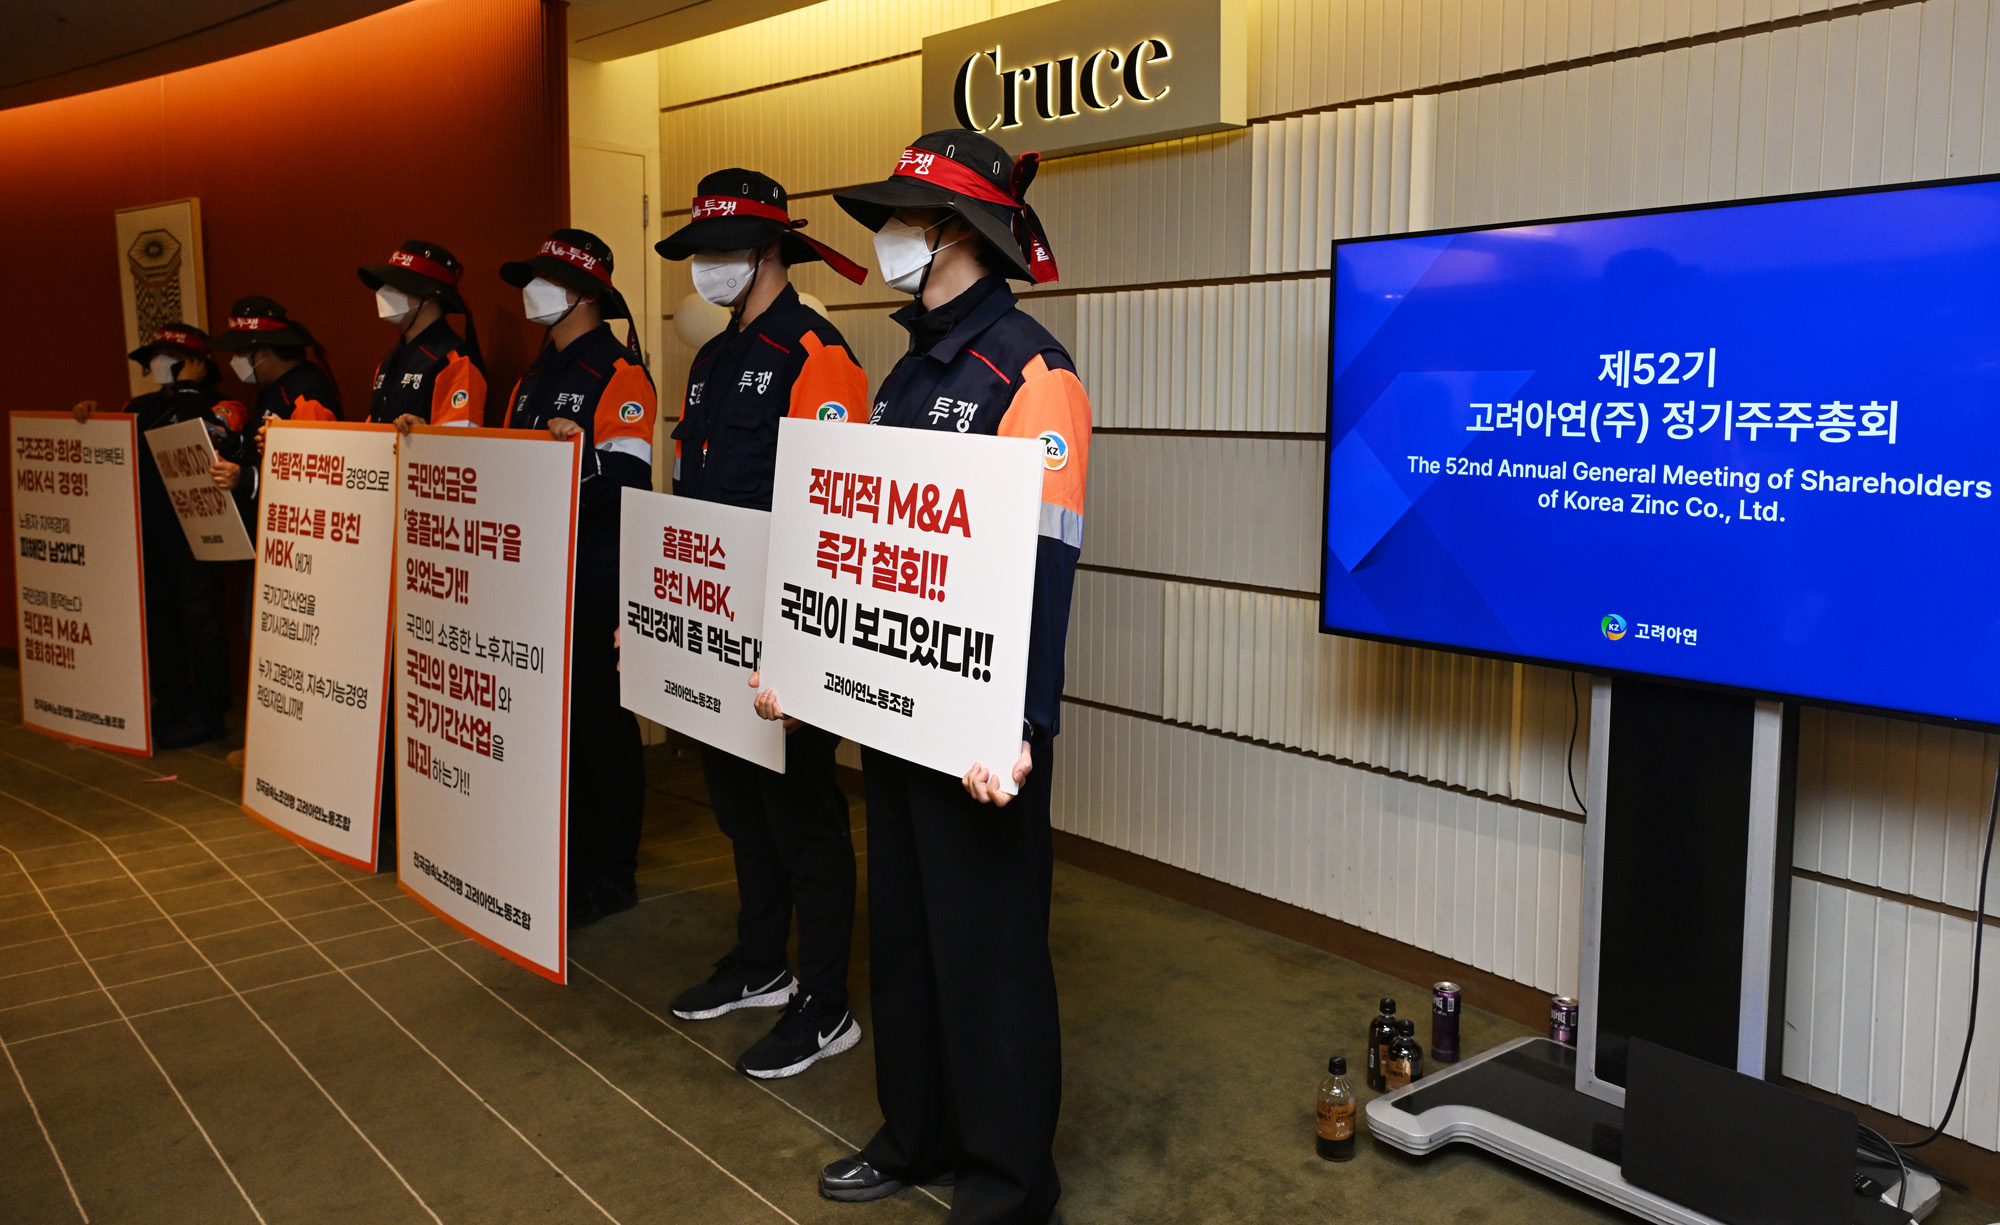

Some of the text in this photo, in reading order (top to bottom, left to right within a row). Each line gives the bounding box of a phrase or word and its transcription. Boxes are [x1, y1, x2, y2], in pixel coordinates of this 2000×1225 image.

[953, 38, 1172, 134] Cruce
[899, 150, 936, 175] 투쟁
[566, 246, 597, 270] 투쟁
[401, 373, 423, 390] 투쟁
[738, 370, 773, 395] 투쟁
[1597, 347, 1717, 388] 제52기
[554, 393, 585, 413] 투쟁
[827, 412, 838, 420] KZ
[928, 396, 979, 433] 투쟁
[1465, 399, 1899, 445] 고려아연(주) 정기주주총회
[271, 451, 390, 492] 약탈적·무책임 경영으로
[1046, 446, 1059, 456] KZ
[17, 468, 89, 497] MBK식 경영!
[407, 462, 478, 505] 국민연금은
[1407, 455, 1993, 500] The 52nd Annual General Meeting of Shareholders
[266, 502, 326, 540] 홈플러스를
[330, 511, 361, 545] 망친
[808, 467, 972, 539] 적대적 M&A
[1538, 489, 1786, 523] of Korea Zinc Co., Ltd.
[662, 525, 726, 571] 홈플러스
[816, 530, 949, 603] 즉각 철회!!
[263, 584, 316, 616] 국가기간산업을
[406, 557, 469, 605] 잊었는가!!
[653, 566, 735, 622] 망친 MBK,
[23, 611, 93, 646] 적대적 M&A
[261, 612, 320, 646] 맡기시겠습니까?
[406, 613, 544, 674] 국민의 소중한 노후자금이
[627, 600, 684, 649] 국민경제
[687, 619, 703, 655] 좀
[781, 581, 994, 683] 국민이 보고있다!!
[1608, 623, 1619, 631] KZ
[1634, 623, 1697, 646] 고려아연
[25, 637, 75, 670] 철회하라!!
[406, 648, 445, 695] 국민의
[258, 657, 272, 681] 누가
[306, 674, 368, 710] 지속가능경영
[664, 679, 721, 714] 고려아연노동조합
[823, 671, 915, 718] 고려아연노동조합
[406, 691, 504, 762] 국가기간산업을
[296, 798, 352, 832] 고려아연노동조합
[413, 851, 532, 931] 전국금속노조연맹 고려아연노동조합
